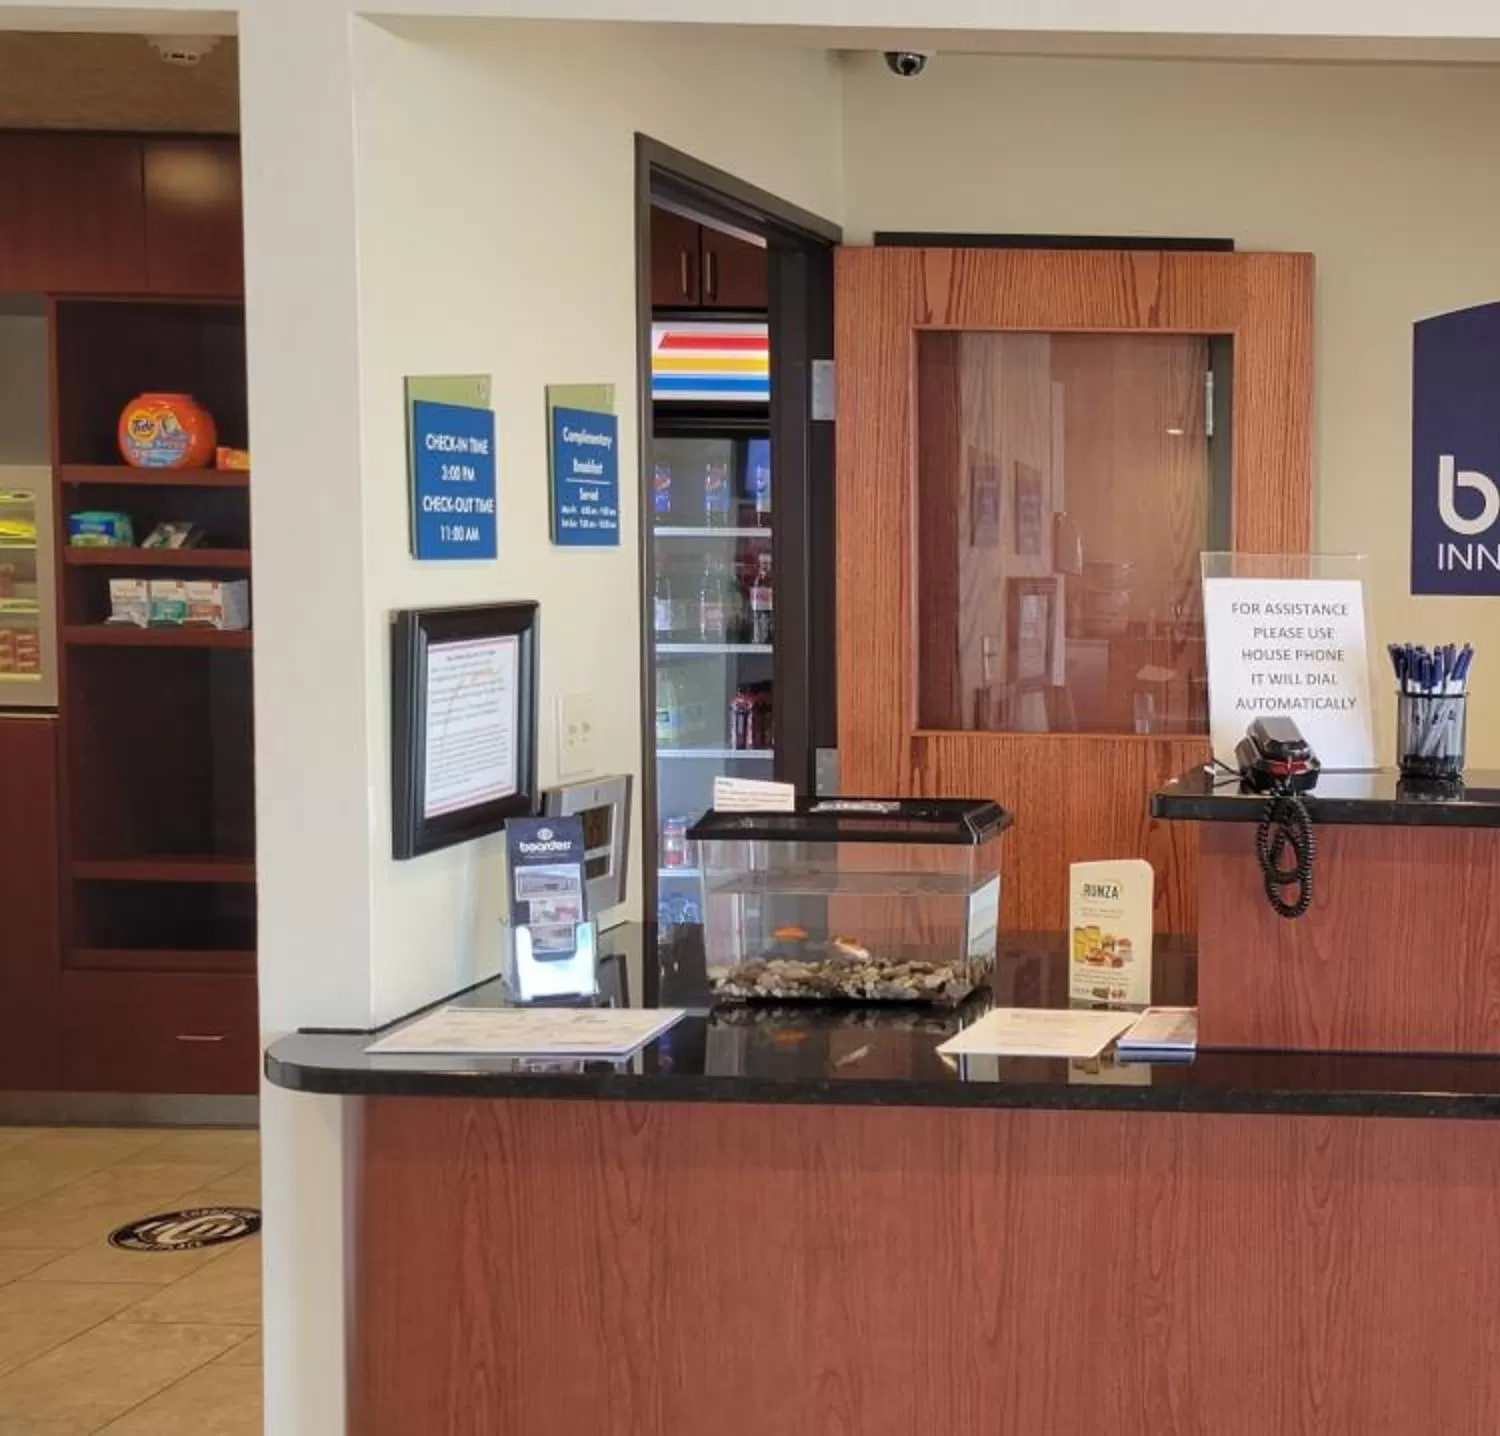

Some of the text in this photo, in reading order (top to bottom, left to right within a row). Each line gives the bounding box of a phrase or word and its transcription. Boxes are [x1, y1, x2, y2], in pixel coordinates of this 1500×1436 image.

[132, 419, 156, 434] Tide
[425, 433, 489, 455] CHECK-IN TIME
[563, 427, 613, 450] Complimentary
[441, 464, 476, 482] 3:00 PM
[423, 495, 496, 513] CHECK-OUT TIME
[440, 524, 480, 542] 11:00 AM
[1231, 602, 1349, 617] FOR ASSISTANCE
[1253, 627, 1335, 640] PLEASE USE
[1241, 649, 1345, 662] HOUSE PHONE
[1251, 673, 1338, 686] IT WILL DIAL
[1235, 697, 1357, 711] AUTOMATICALLY
[519, 841, 572, 853] boarders
[1083, 883, 1120, 901] RUNZA
